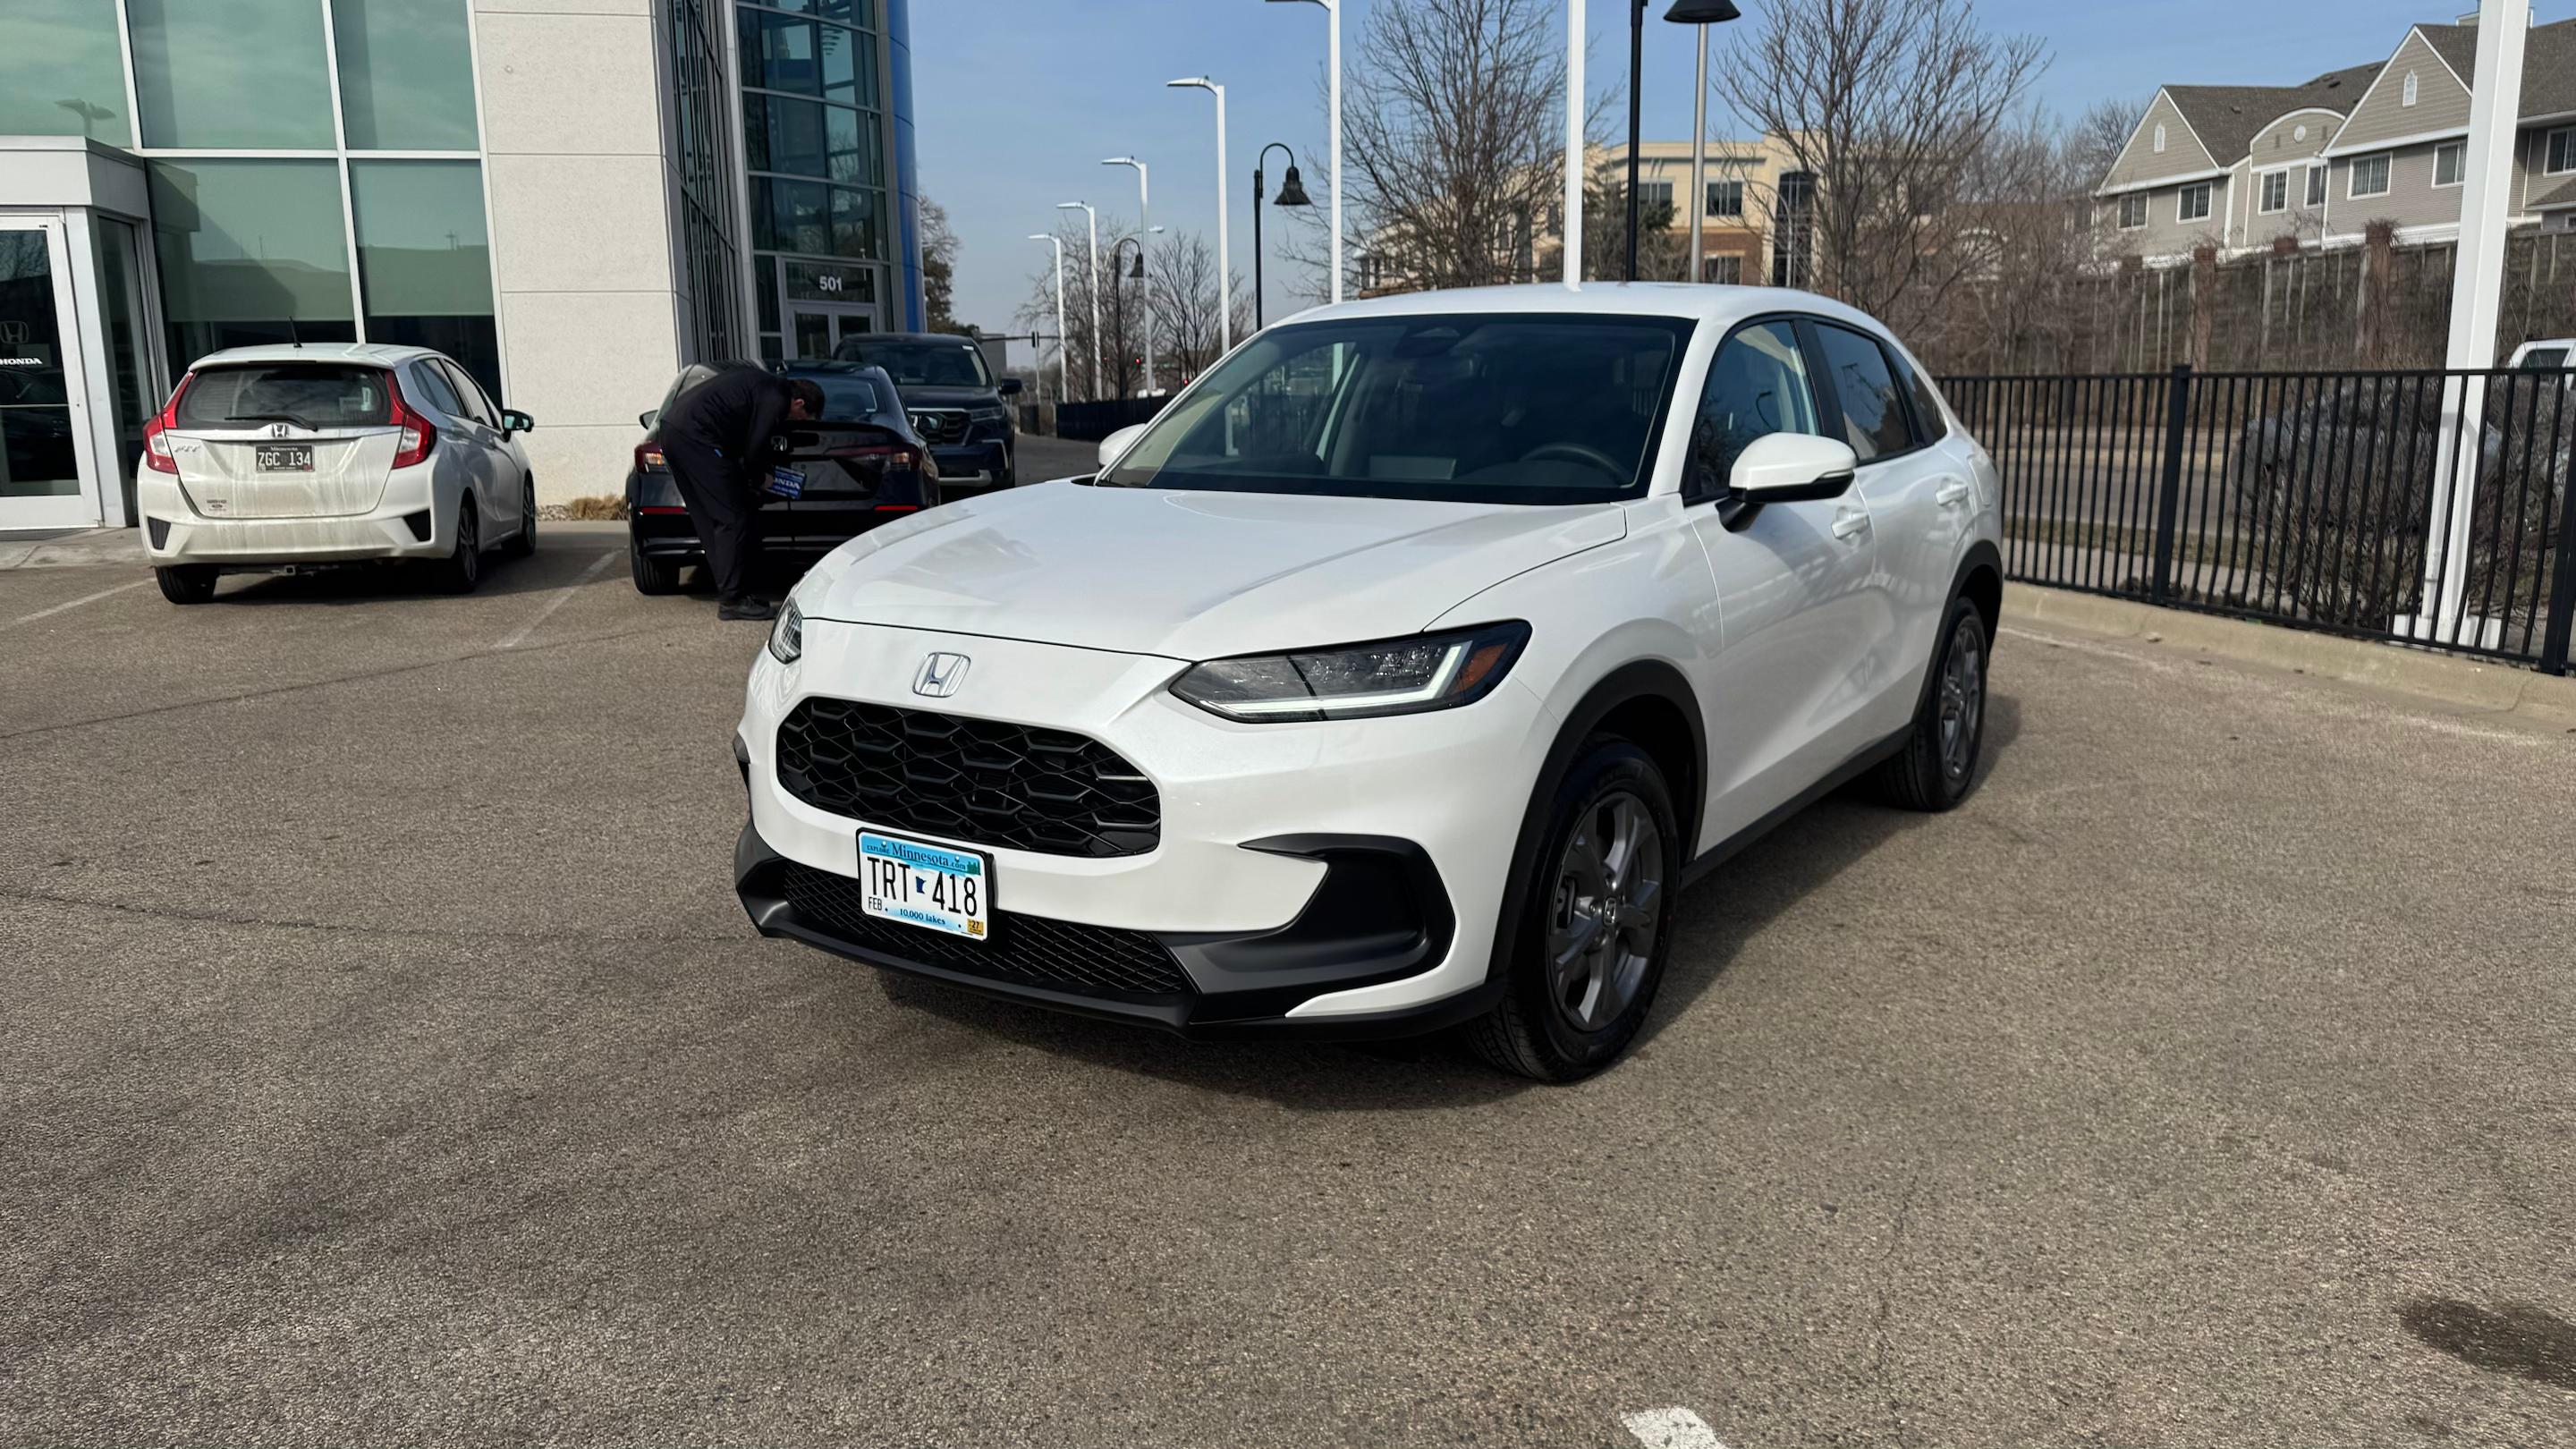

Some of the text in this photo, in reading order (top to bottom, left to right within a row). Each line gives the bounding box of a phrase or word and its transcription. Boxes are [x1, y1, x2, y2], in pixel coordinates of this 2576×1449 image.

[819, 275, 842, 292] 501
[258, 452, 311, 466] ZGC 134
[867, 856, 977, 917] TRT 418
[869, 896, 883, 911] FEB
[926, 913, 946, 925] lakes
